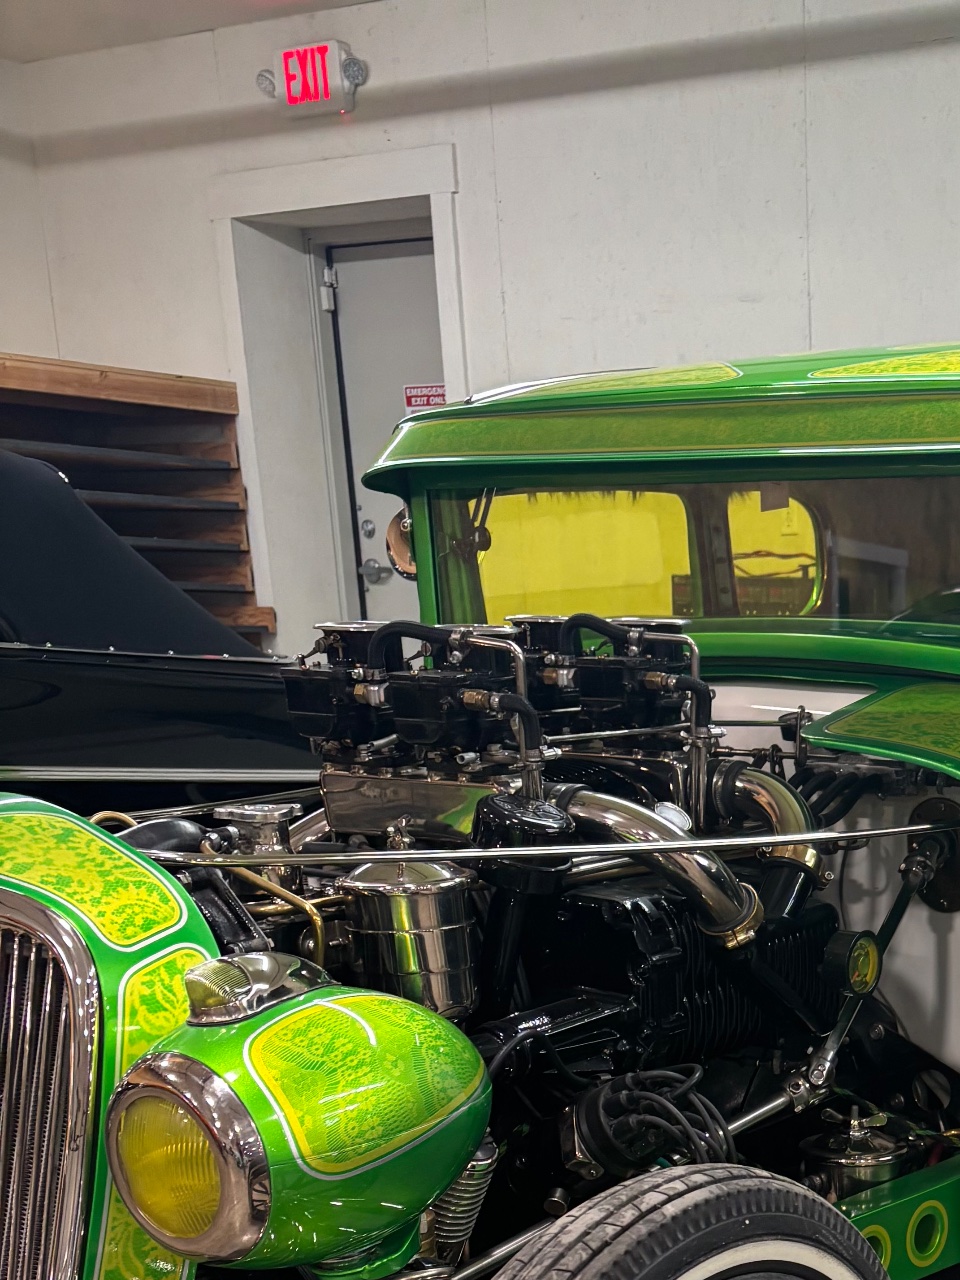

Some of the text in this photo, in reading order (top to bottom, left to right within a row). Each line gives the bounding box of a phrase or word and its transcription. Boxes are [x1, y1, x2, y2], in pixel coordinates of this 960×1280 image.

[283, 45, 330, 105] EXIT
[406, 387, 446, 396] EMERGENC
[411, 396, 446, 405] EXIT ONL
